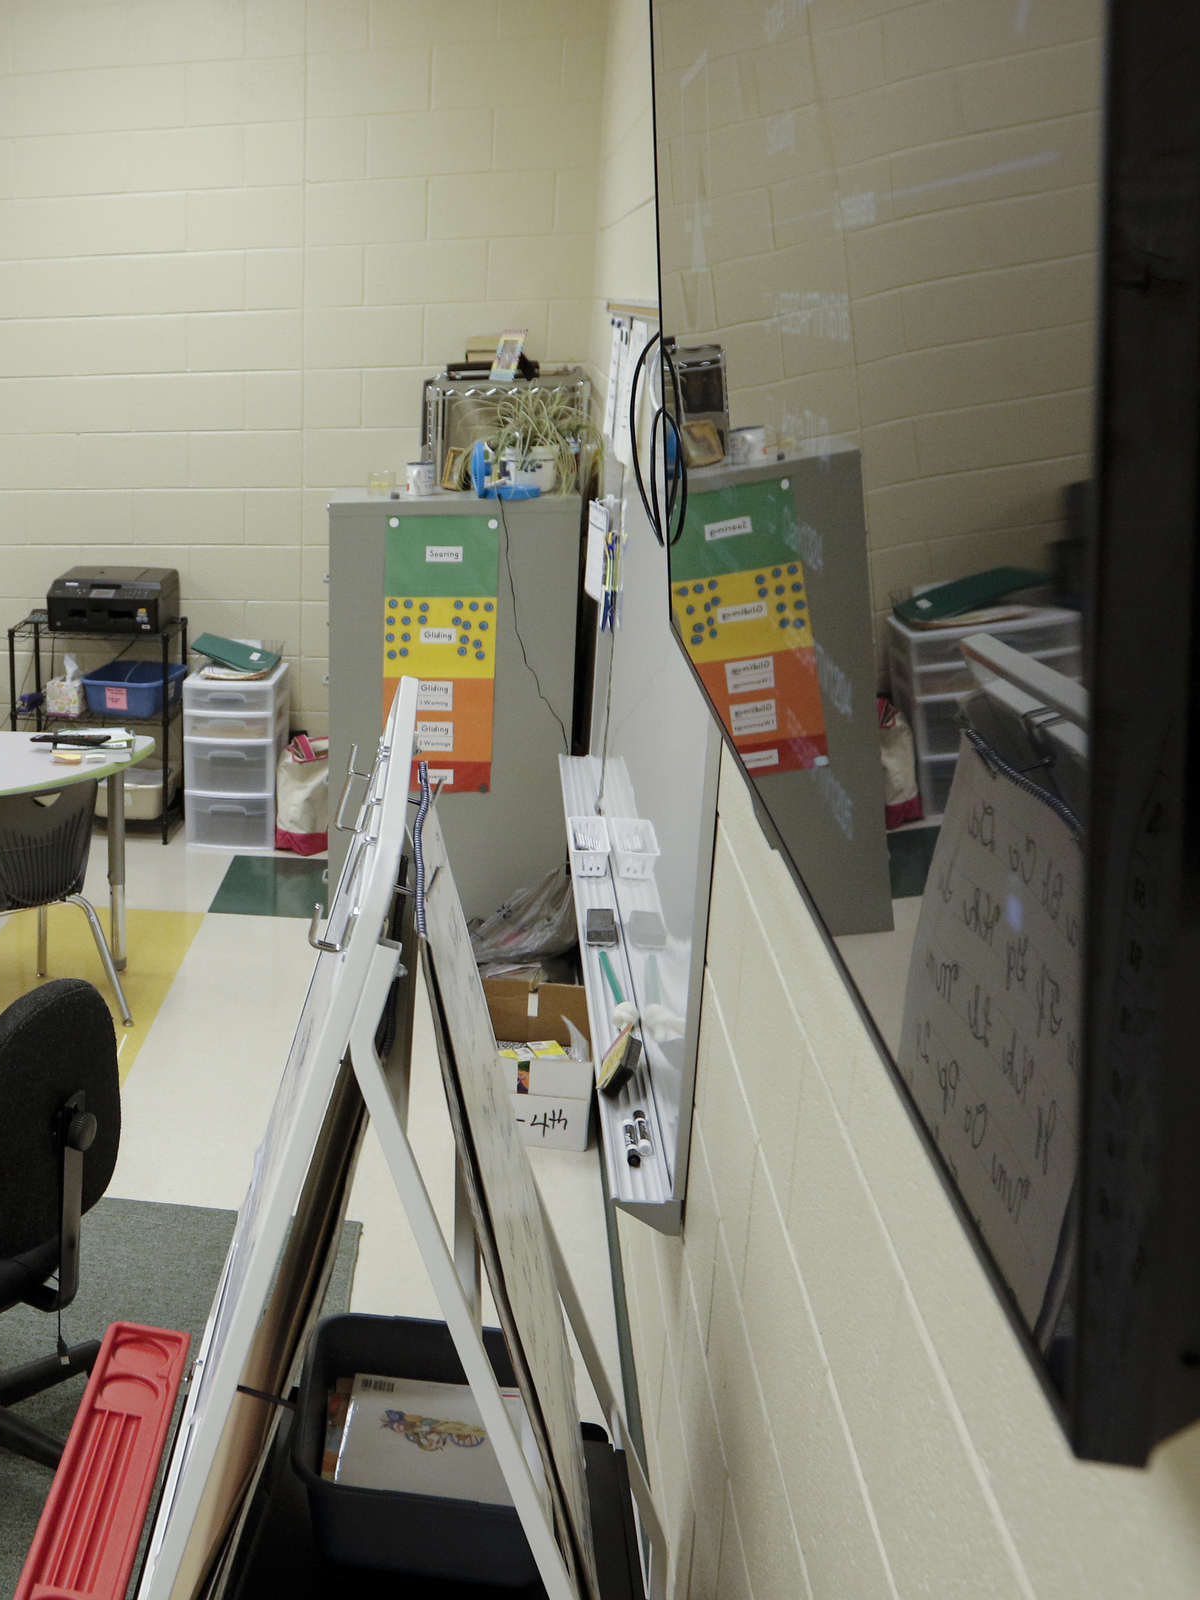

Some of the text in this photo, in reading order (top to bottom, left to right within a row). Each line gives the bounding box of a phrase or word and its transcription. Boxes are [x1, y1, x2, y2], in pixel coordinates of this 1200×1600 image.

[429, 549, 460, 562] Soaring
[424, 631, 453, 642] Gliding
[420, 684, 449, 694] Gliding
[424, 699, 449, 708] Warning
[421, 724, 449, 735] Gliding
[423, 740, 451, 748] Warnings
